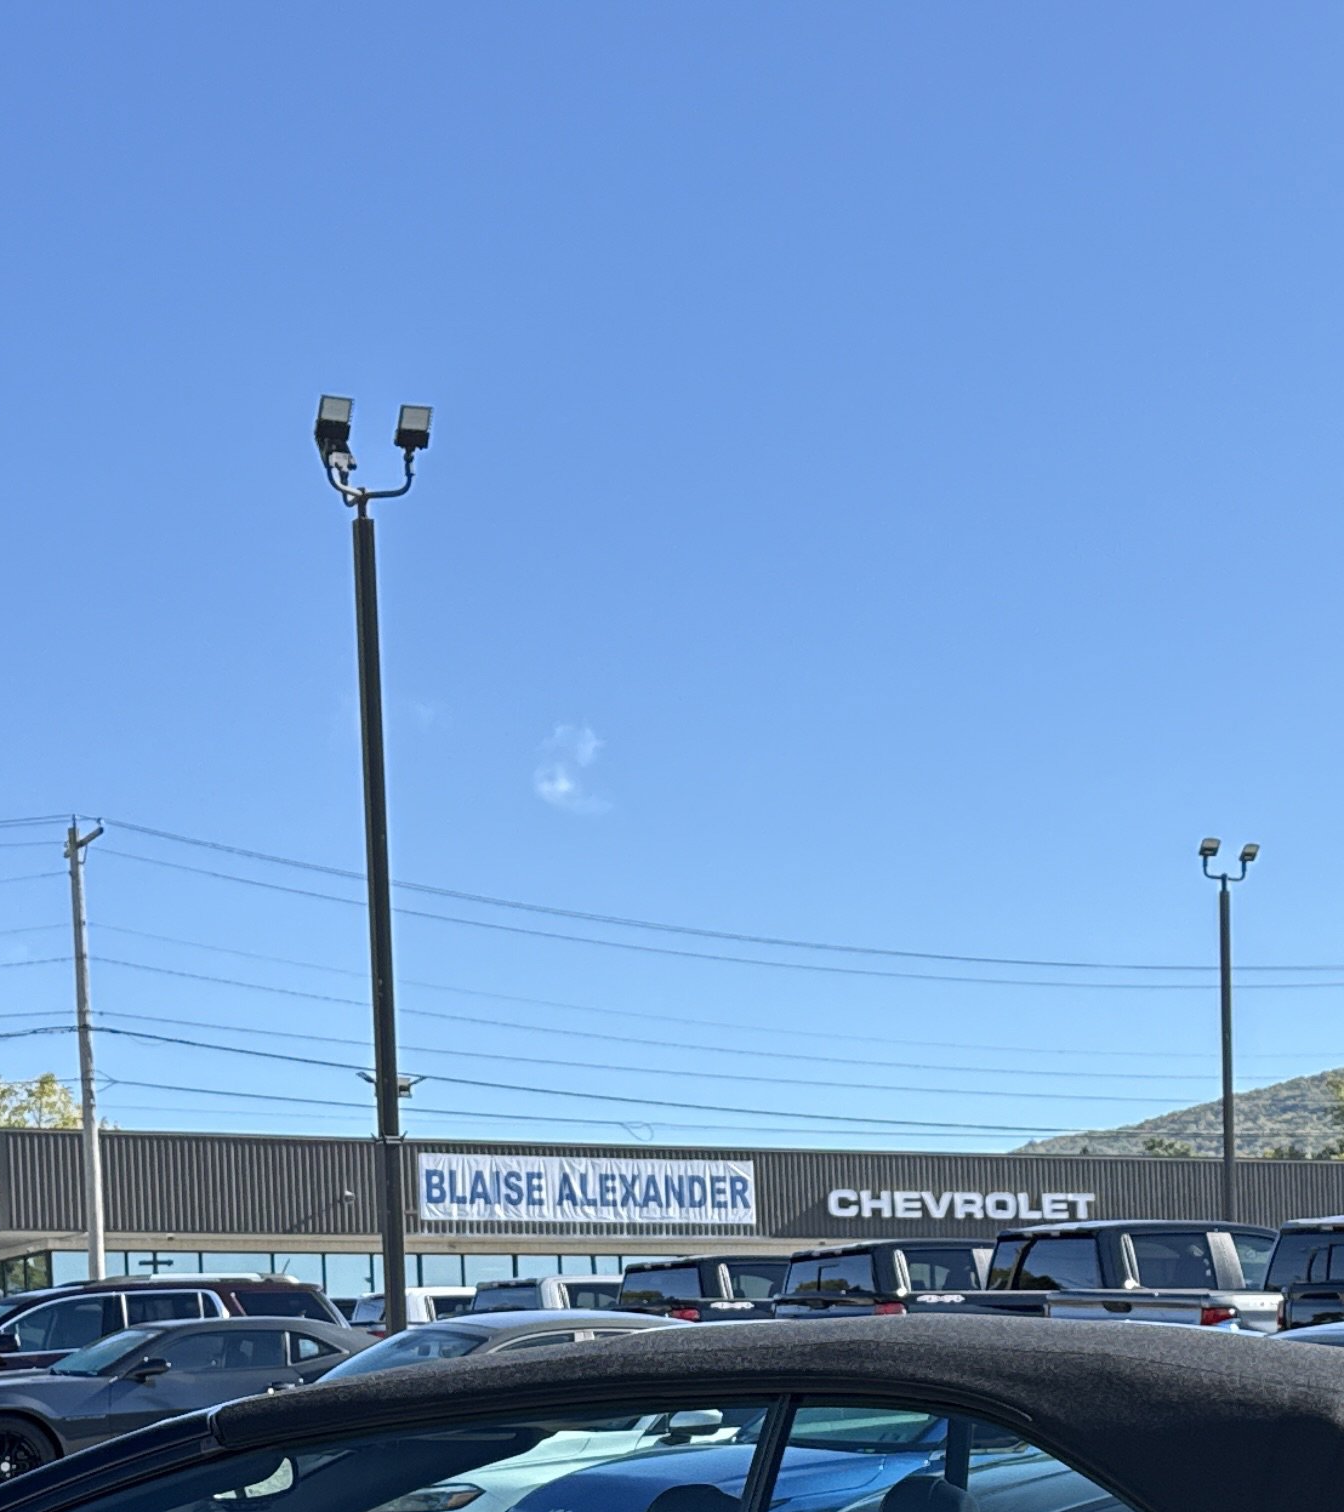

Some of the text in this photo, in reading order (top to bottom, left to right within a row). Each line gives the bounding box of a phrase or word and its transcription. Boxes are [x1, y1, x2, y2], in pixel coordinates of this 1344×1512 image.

[424, 1168, 751, 1209] BLAISE ALEXANDER
[827, 1189, 1096, 1220] CHEVROLET
